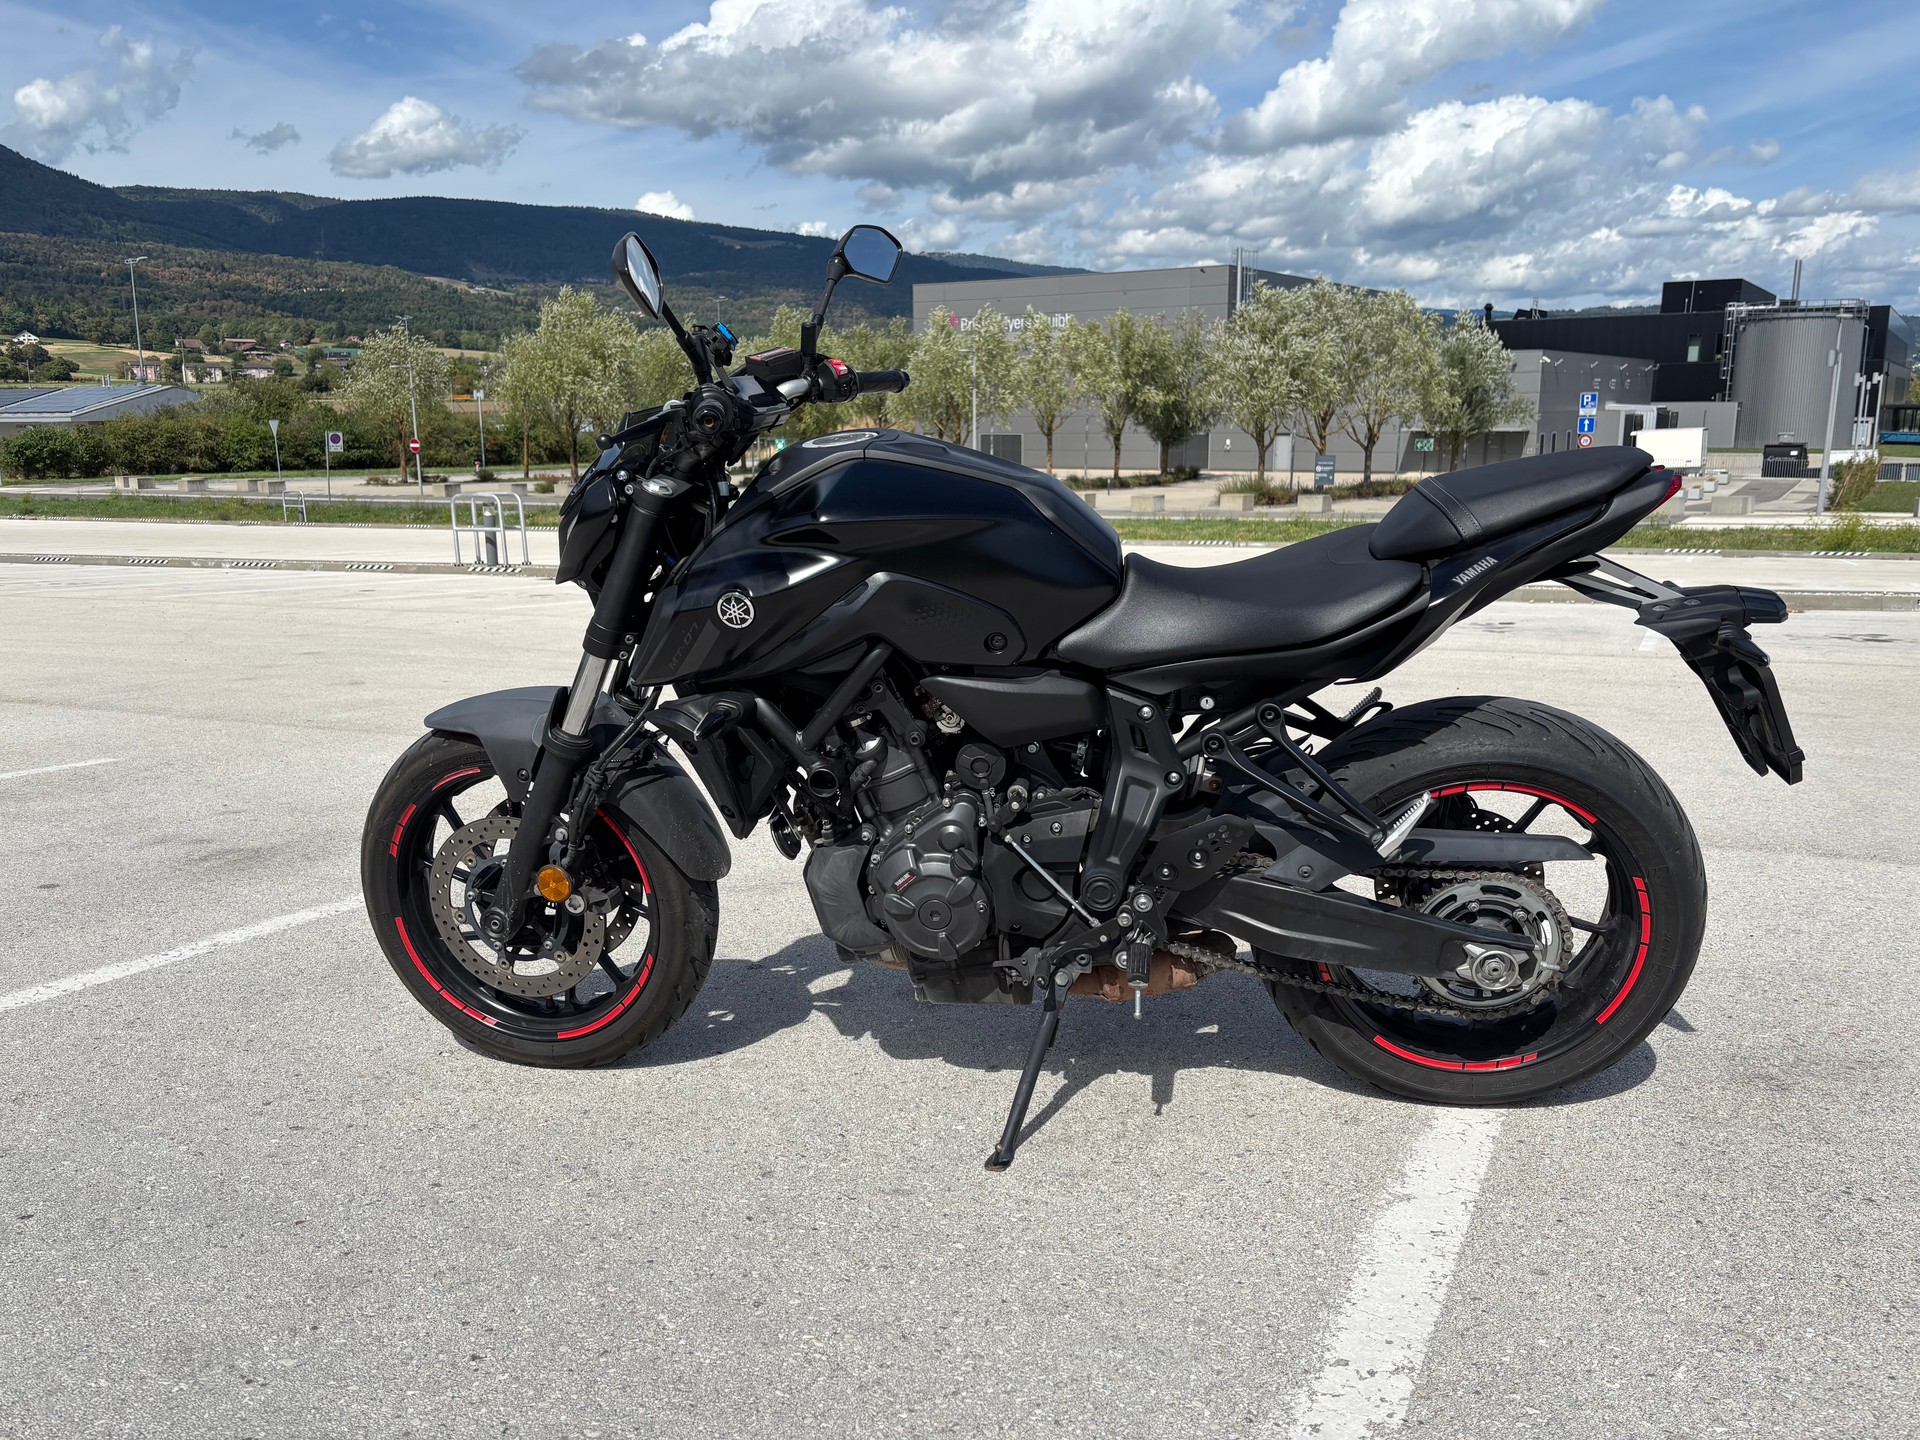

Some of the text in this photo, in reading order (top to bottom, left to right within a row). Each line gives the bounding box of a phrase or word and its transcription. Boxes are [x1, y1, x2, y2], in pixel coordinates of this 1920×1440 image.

[1583, 394, 1592, 406] P
[1451, 556, 1498, 585] YAMAHA
[669, 621, 699, 670] MT-07
